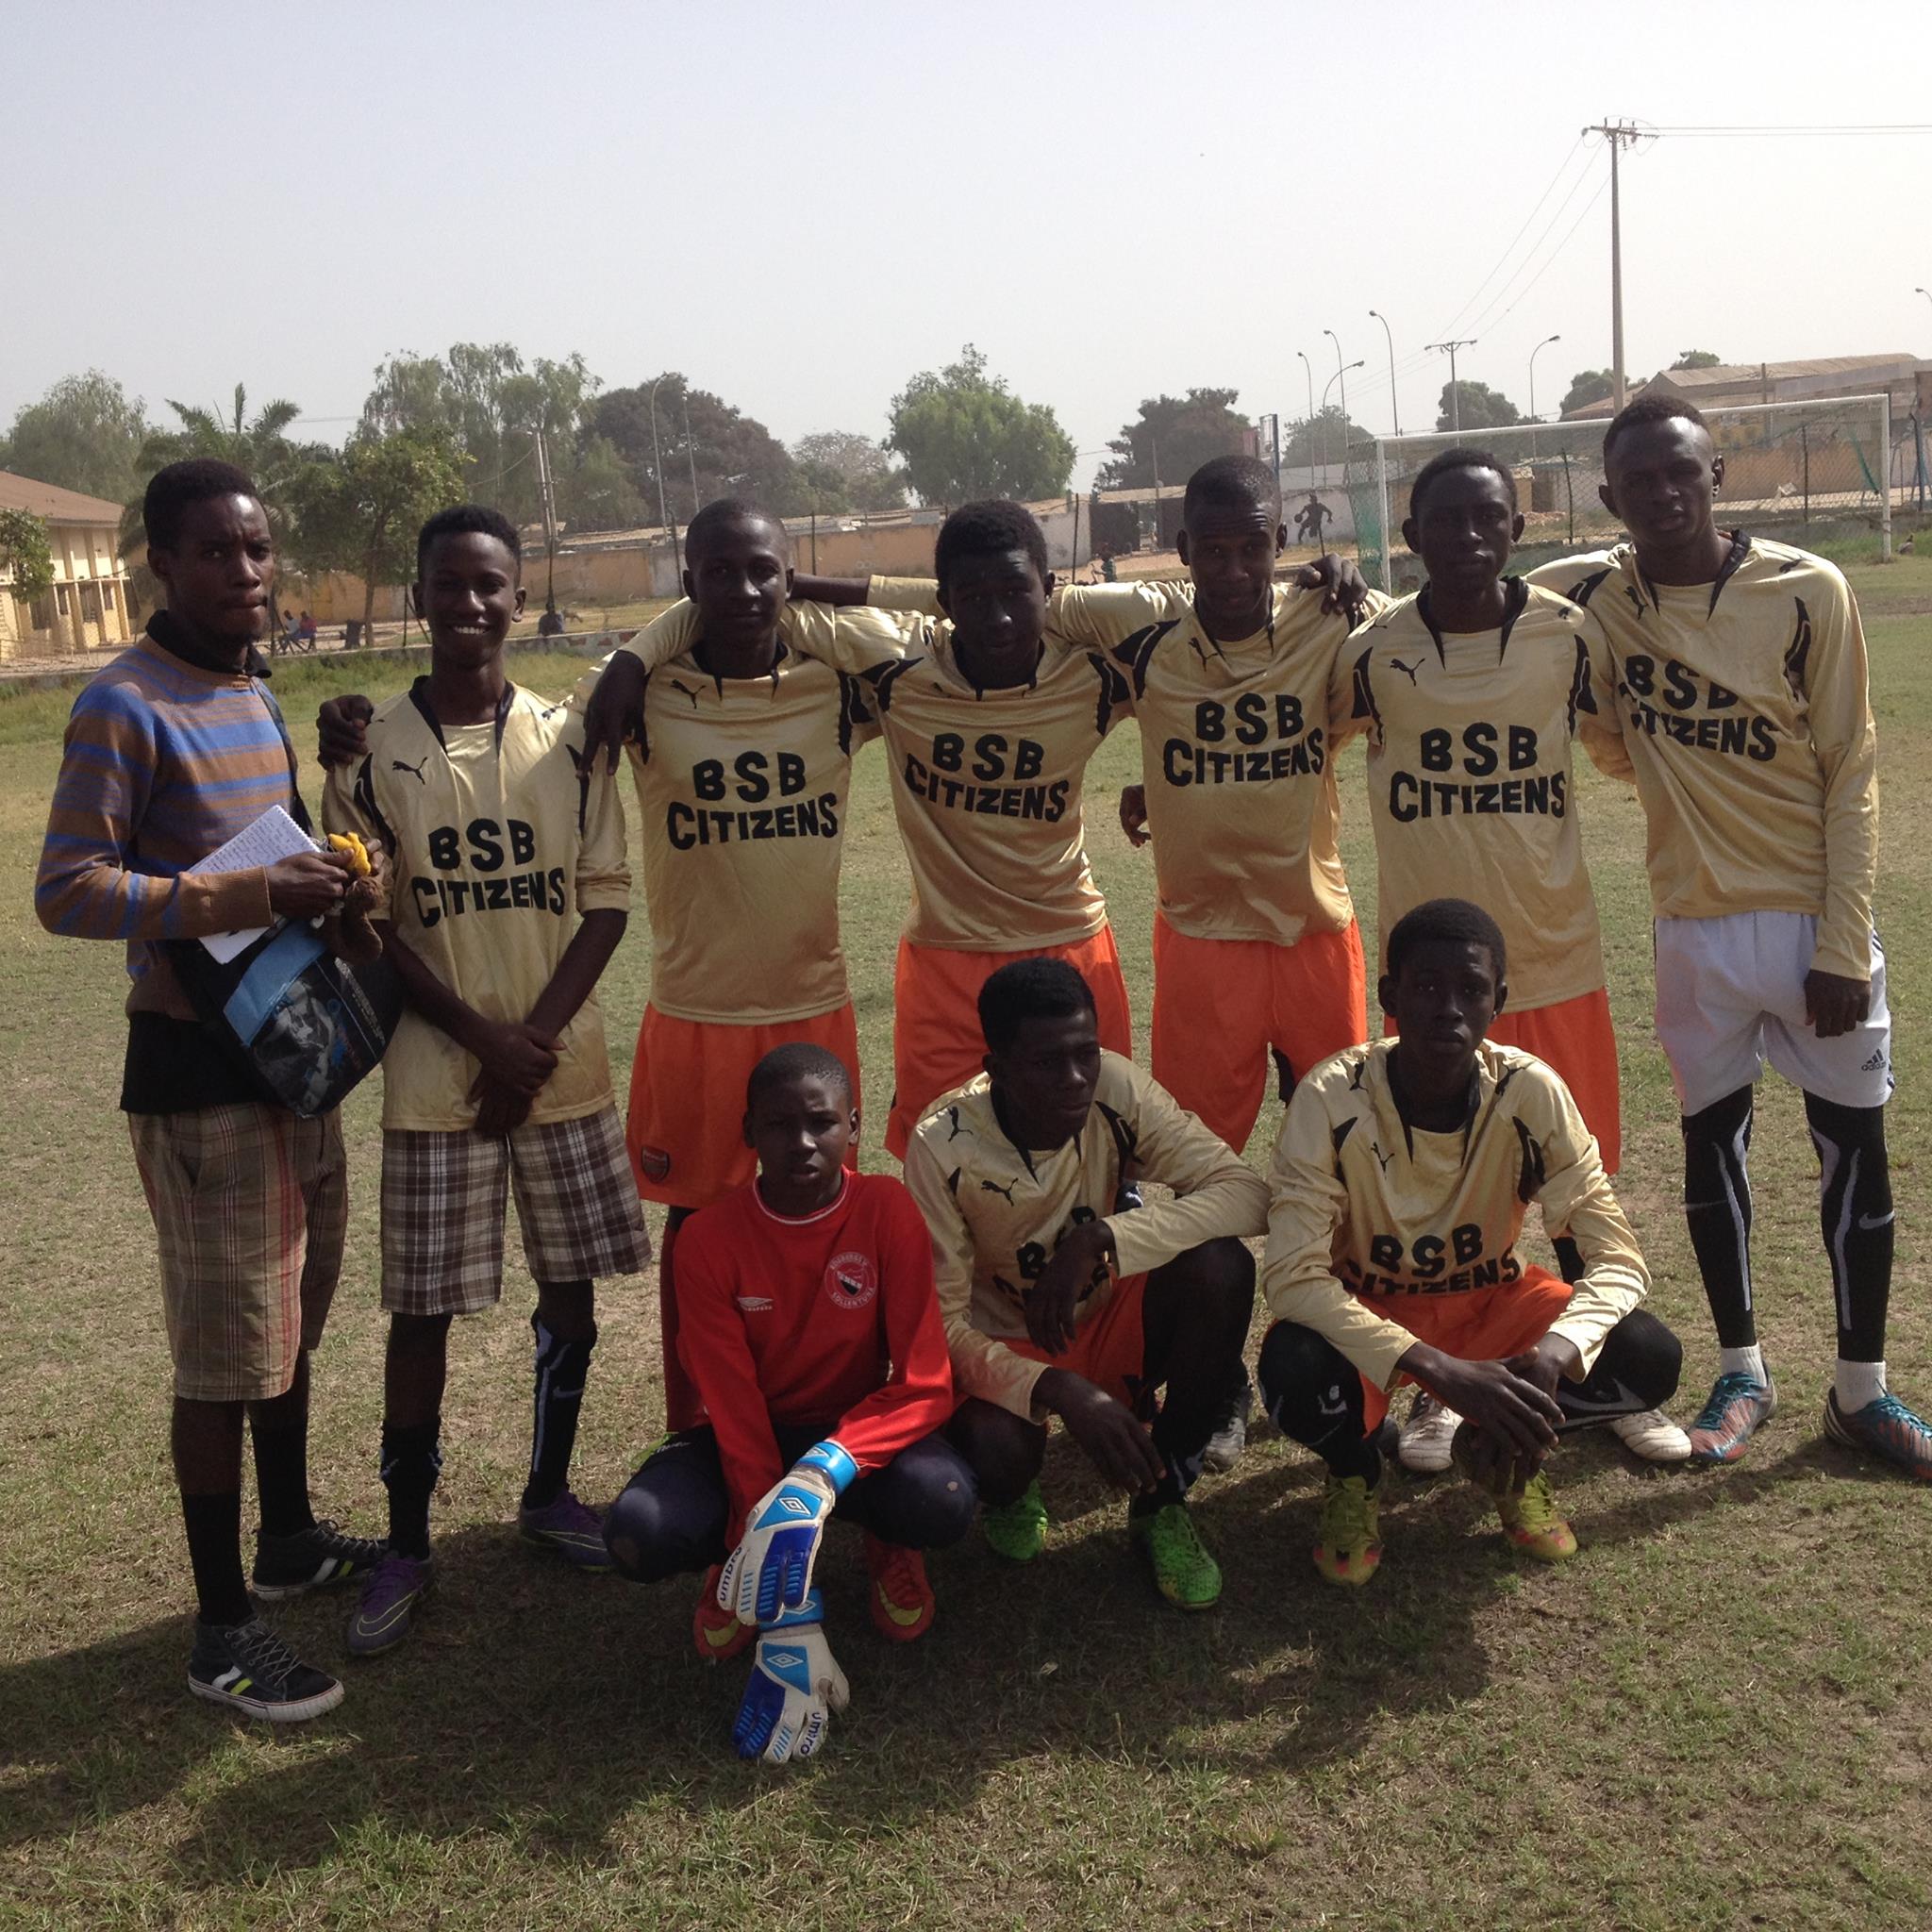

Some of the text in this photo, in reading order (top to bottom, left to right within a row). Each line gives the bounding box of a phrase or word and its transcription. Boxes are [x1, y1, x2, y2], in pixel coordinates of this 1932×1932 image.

[1195, 692, 1304, 746] BSB
[933, 732, 1044, 782] BSB
[1163, 727, 1324, 788] CITIZENS
[1421, 722, 1538, 777] BSB
[692, 751, 807, 804] BSB
[905, 753, 1070, 824] CITIZENS
[1390, 771, 1567, 823] CITIZENS
[428, 818, 535, 873] BSB
[667, 792, 839, 850] CITIZENS
[411, 867, 566, 928] CITIZENS
[1370, 1223, 1484, 1278] BSB
[720, 1546, 742, 1602] umbro
